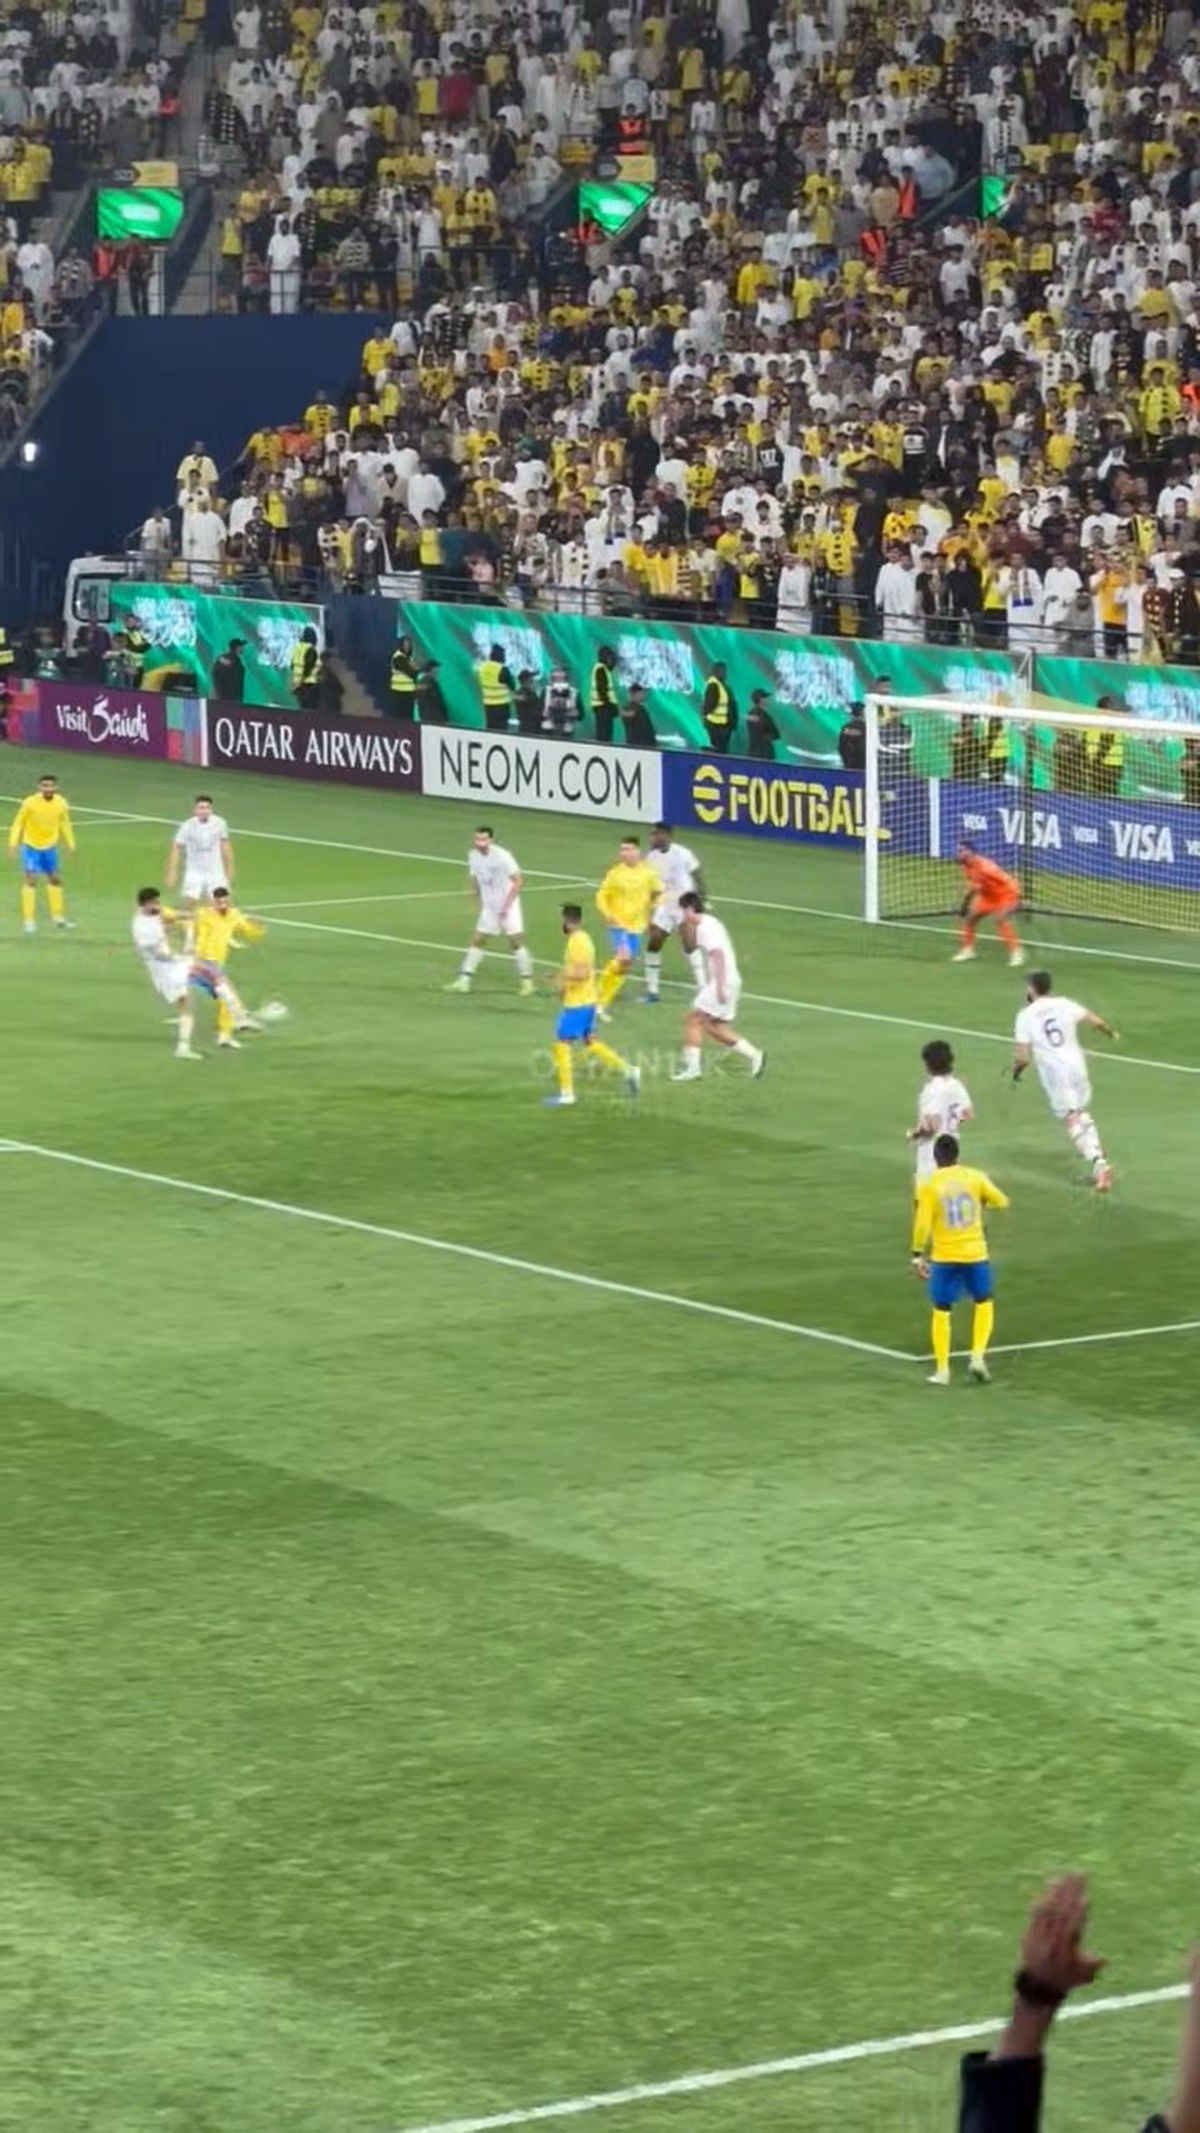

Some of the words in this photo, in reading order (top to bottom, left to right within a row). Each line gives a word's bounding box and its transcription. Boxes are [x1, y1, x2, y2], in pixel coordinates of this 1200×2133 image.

[55, 704, 88, 733] Visit
[215, 717, 295, 761] QATAR
[304, 728, 413, 775] AIRWAYS
[440, 736, 642, 810] NEOM.COM
[998, 807, 1062, 850] VISA
[1110, 820, 1175, 863] VISA
[1043, 1017, 1066, 1049] 6
[940, 1191, 975, 1229] 10
